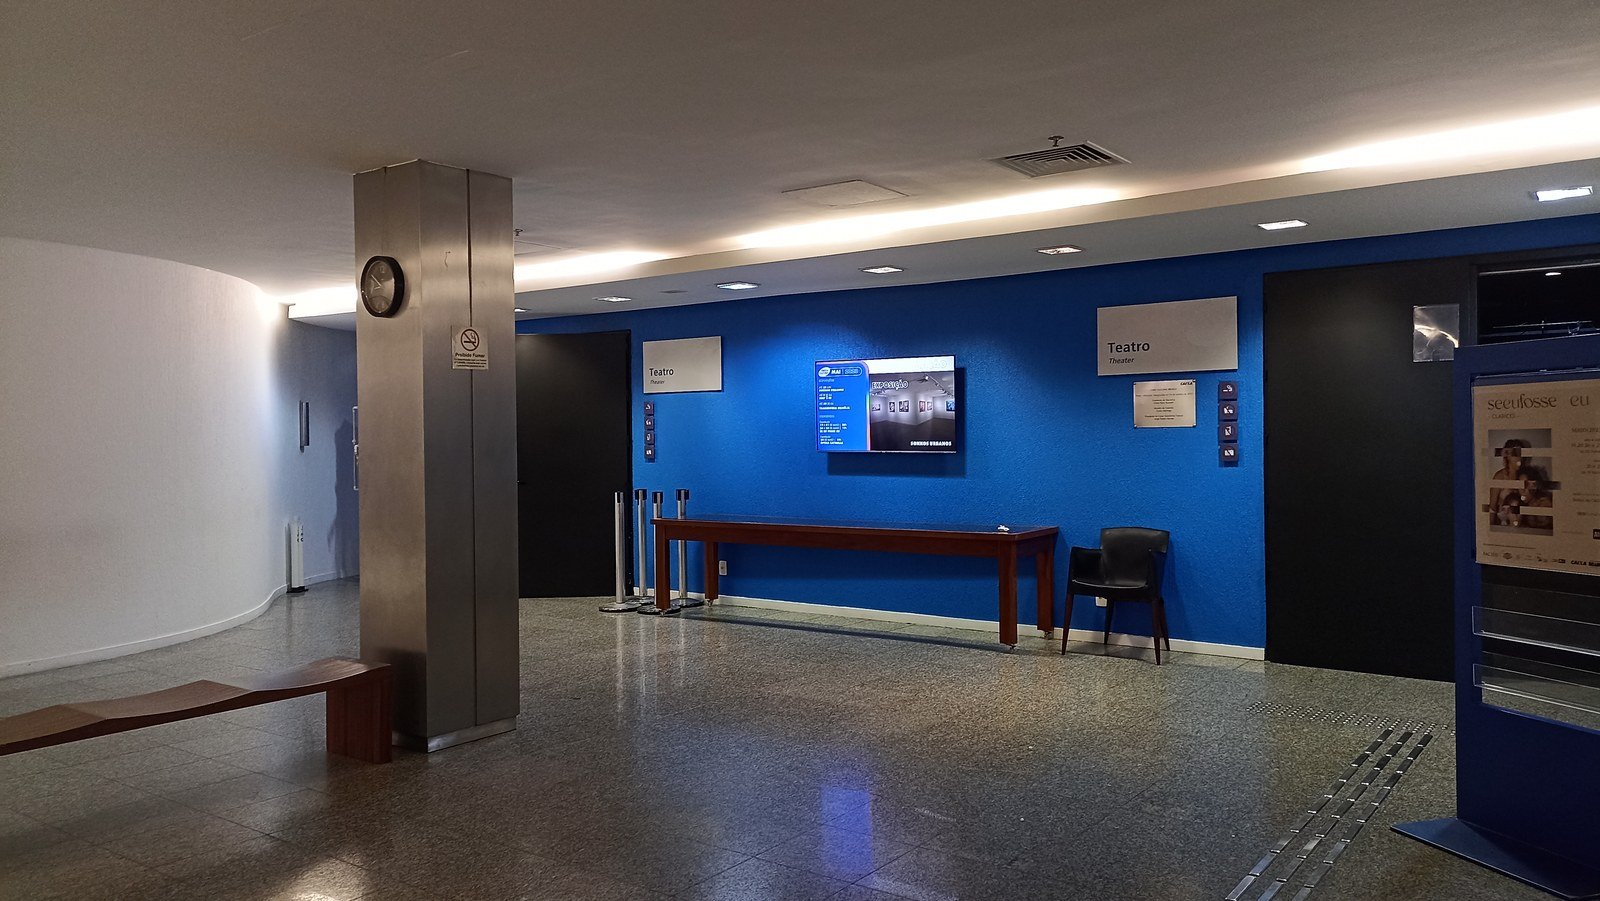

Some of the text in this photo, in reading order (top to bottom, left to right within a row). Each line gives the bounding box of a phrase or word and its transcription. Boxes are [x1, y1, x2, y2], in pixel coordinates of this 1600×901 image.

[1107, 341, 1150, 353] Teatro
[649, 367, 674, 377] Teatro
[871, 379, 909, 391] EXPOSIÇÃO
[1570, 395, 1590, 407] eu
